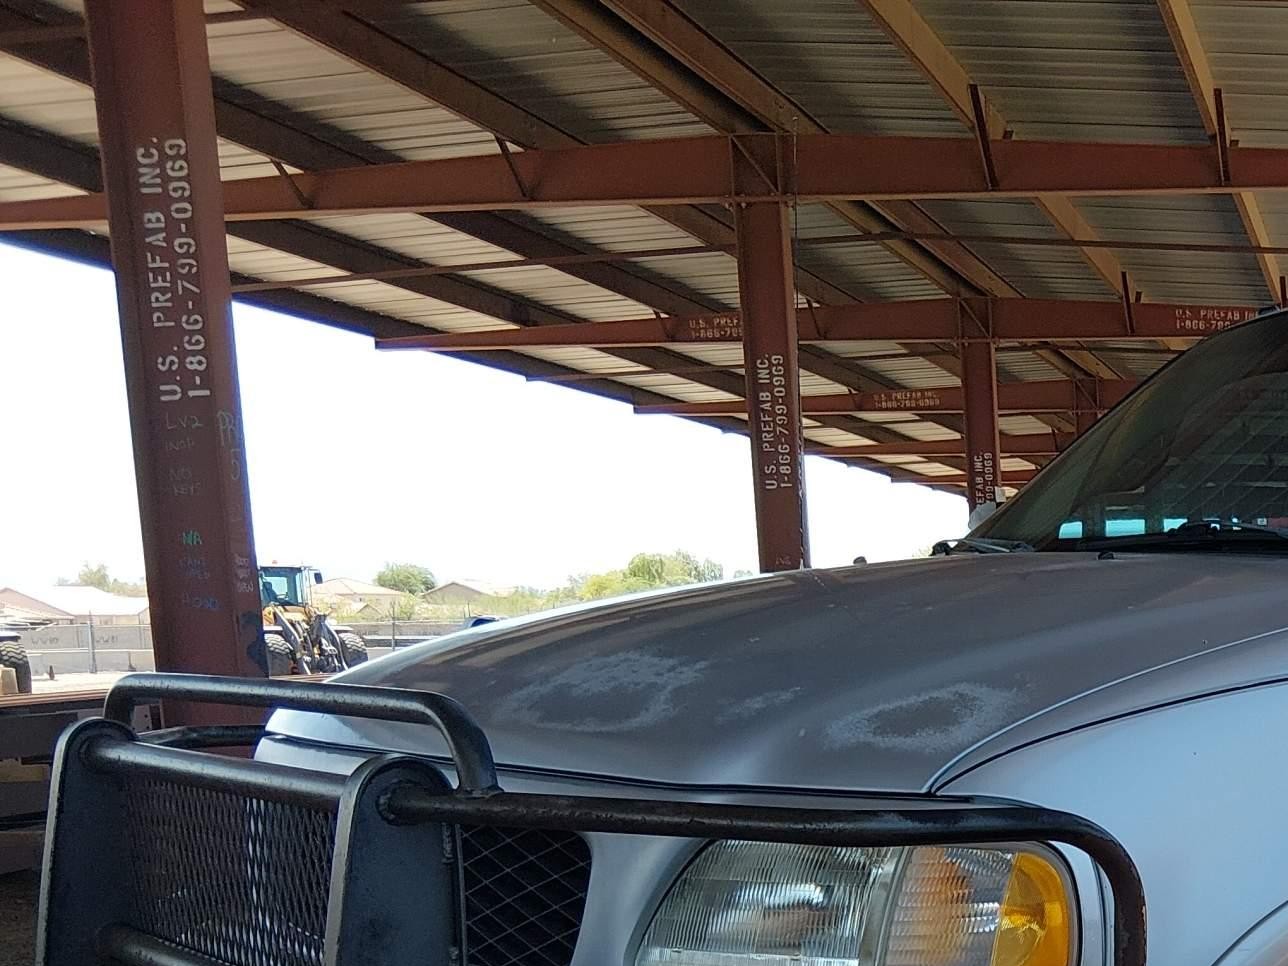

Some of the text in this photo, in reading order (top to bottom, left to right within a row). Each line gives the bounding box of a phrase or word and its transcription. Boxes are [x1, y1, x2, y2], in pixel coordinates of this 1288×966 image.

[137, 136, 183, 401] U.S. PREFAB INC.
[164, 138, 211, 398] 1-866-799-0969
[757, 353, 778, 489] U.S. PREFAB INC.
[771, 354, 792, 488] 1-866-799-0969
